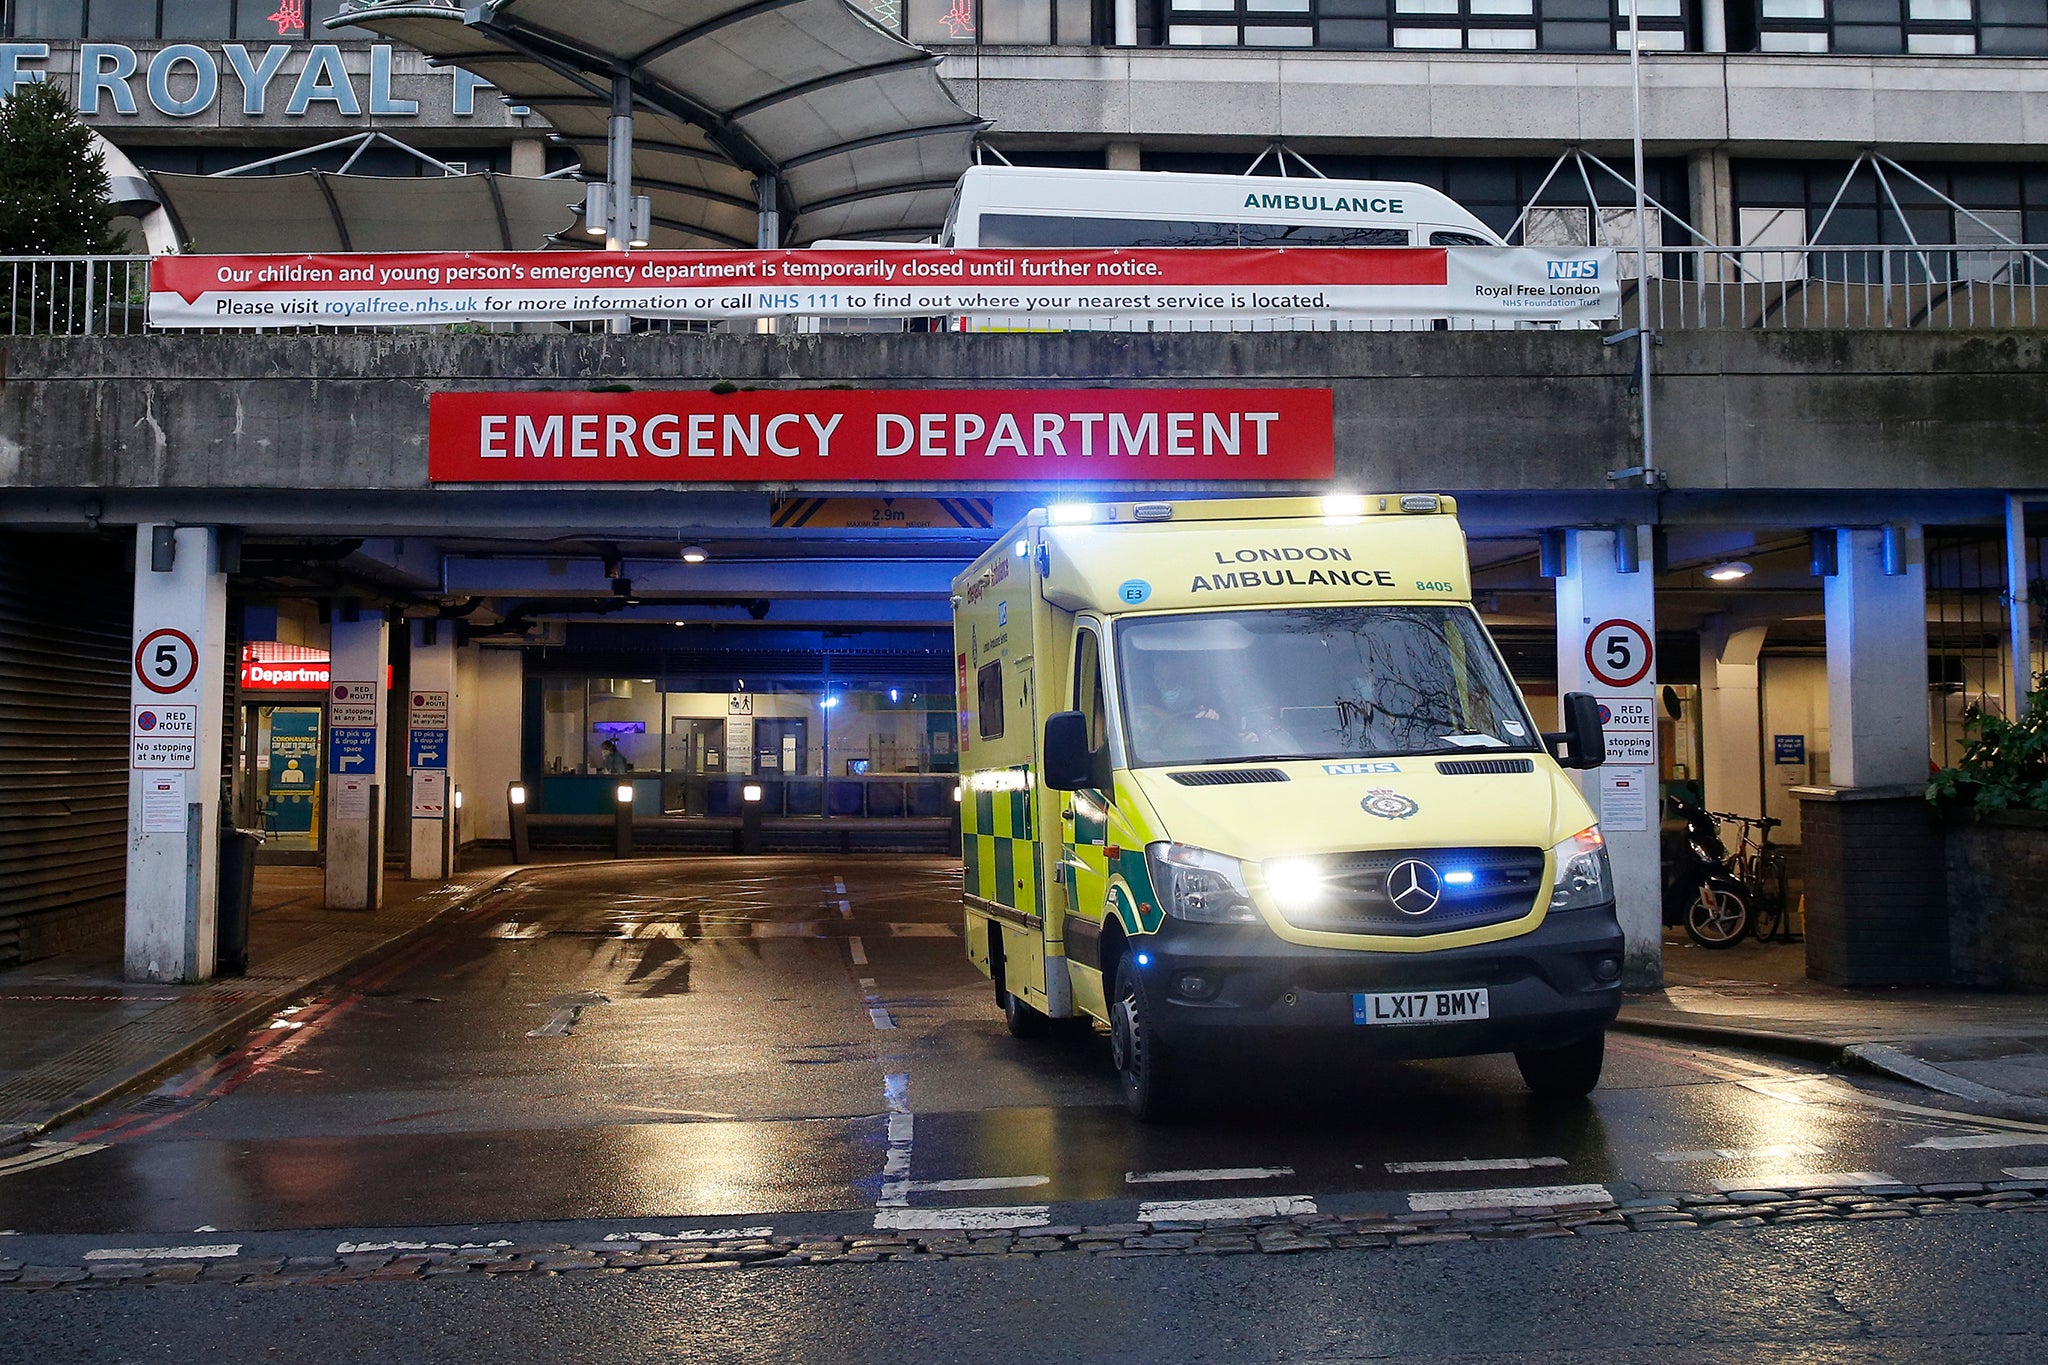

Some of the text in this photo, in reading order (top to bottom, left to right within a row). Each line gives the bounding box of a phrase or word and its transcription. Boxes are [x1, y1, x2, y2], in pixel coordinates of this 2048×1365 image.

[78, 44, 419, 117] ROYAL
[1244, 193, 1404, 213] AMBULANCE
[216, 266, 252, 282] Our
[257, 264, 333, 282] children
[338, 264, 374, 281] and
[379, 267, 440, 285] young
[530, 265, 636, 284] emergency
[641, 261, 755, 282] department
[761, 260, 776, 276] is
[781, 260, 896, 281] temporarily
[902, 259, 963, 276] closed
[969, 259, 1014, 276] until
[1020, 259, 1090, 276] further
[1096, 259, 1163, 276] notice.
[1549, 261, 1597, 279] NHS
[1475, 283, 1600, 299] Royal Free London
[216, 293, 1330, 317] Please visit royalfree.nhs.uk for more information or call NHS 111 to find out where your nearest service is located.
[1524, 299, 1576, 307] Foundation
[480, 413, 1280, 457] EMERGENCY DEPARTMENT
[872, 509, 905, 520] 2.9m
[1215, 547, 1352, 564] LONDON
[1190, 570, 1396, 592] AMBULANCE
[1416, 580, 1453, 592] 8405
[1127, 590, 1142, 599] E3
[1606, 636, 1631, 669] 5
[155, 645, 178, 677] 5
[251, 667, 330, 685] Departme
[166, 712, 186, 720] RED
[1621, 706, 1642, 714] RED
[159, 722, 192, 731] ROUTE
[1614, 715, 1650, 724] ROUTE
[136, 743, 193, 752] No stopping
[1609, 738, 1650, 748] stopping
[1606, 748, 1649, 757] any time
[1328, 763, 1397, 775] NHS
[1375, 992, 1480, 1019] LX17 BMY
